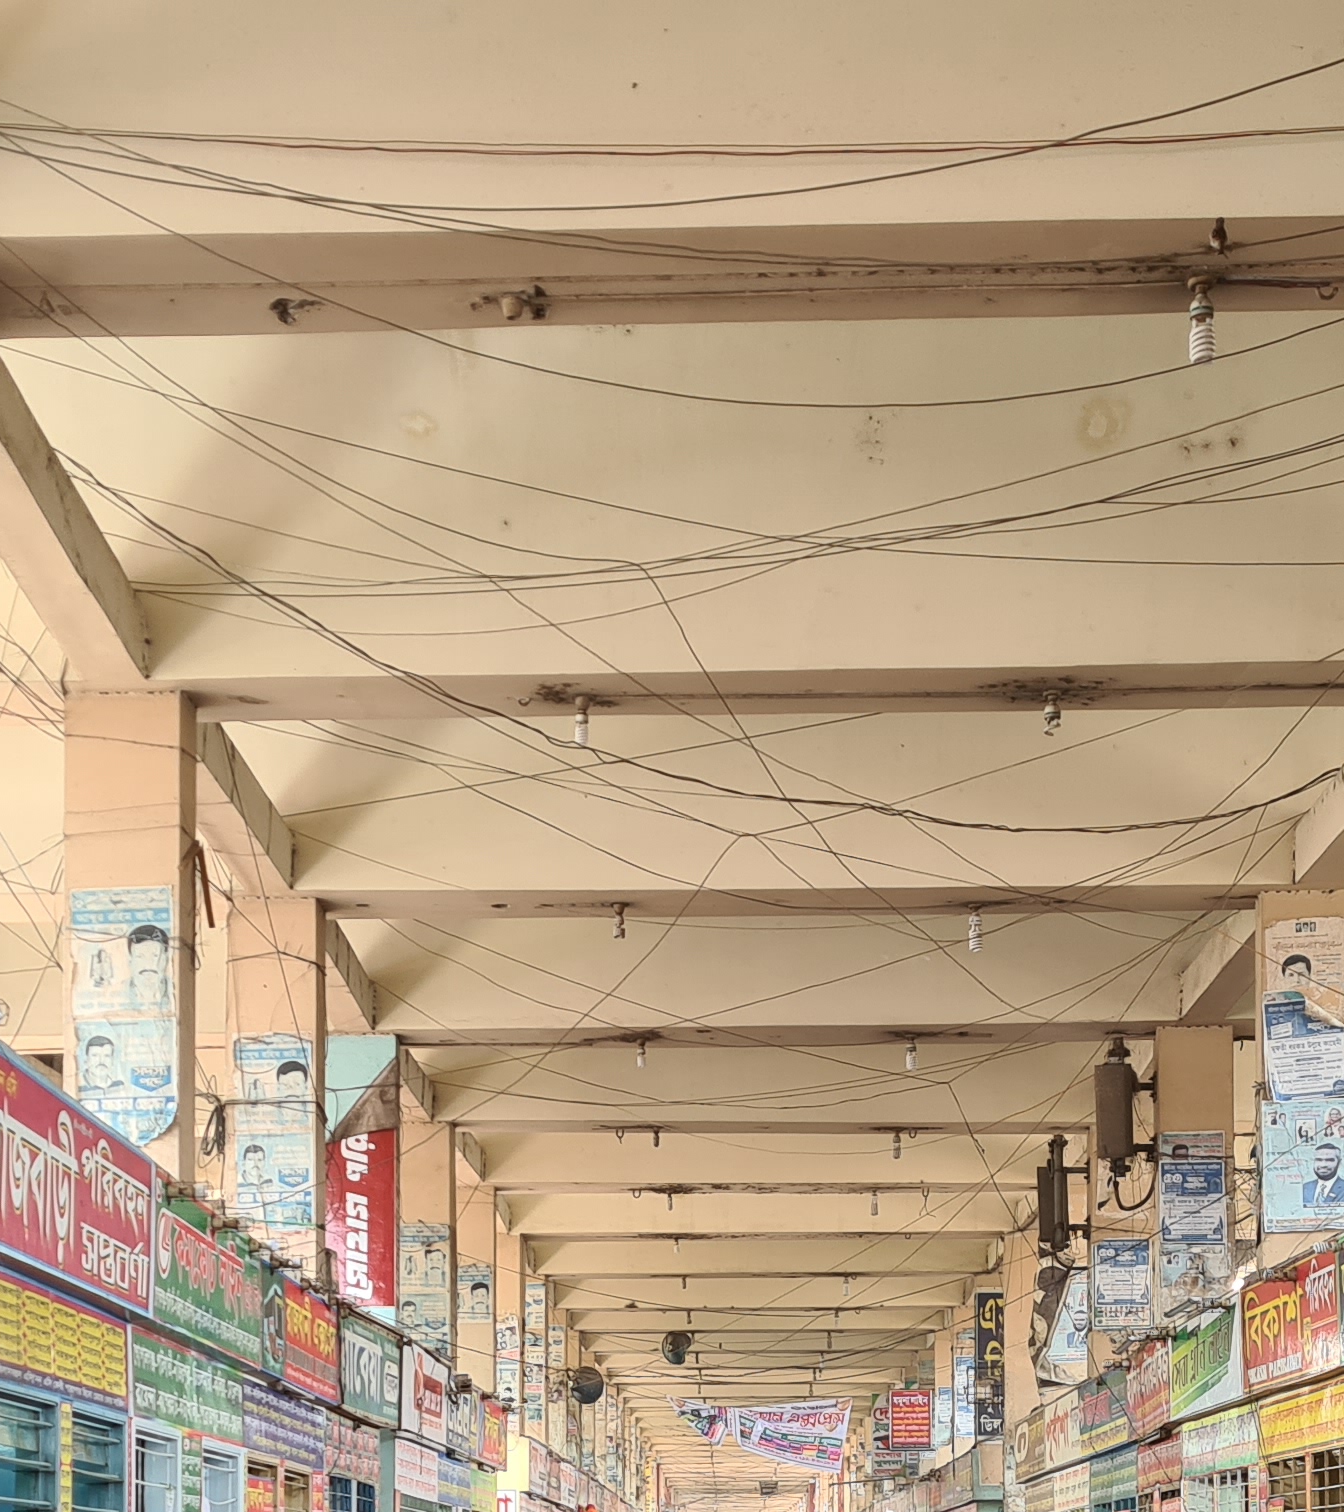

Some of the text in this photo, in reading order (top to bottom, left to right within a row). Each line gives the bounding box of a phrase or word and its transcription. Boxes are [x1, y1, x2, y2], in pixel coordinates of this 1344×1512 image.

[81, 1137, 151, 1241] পরিবহন
[1244, 1258, 1337, 1362] বিকাশ পরিবহন
